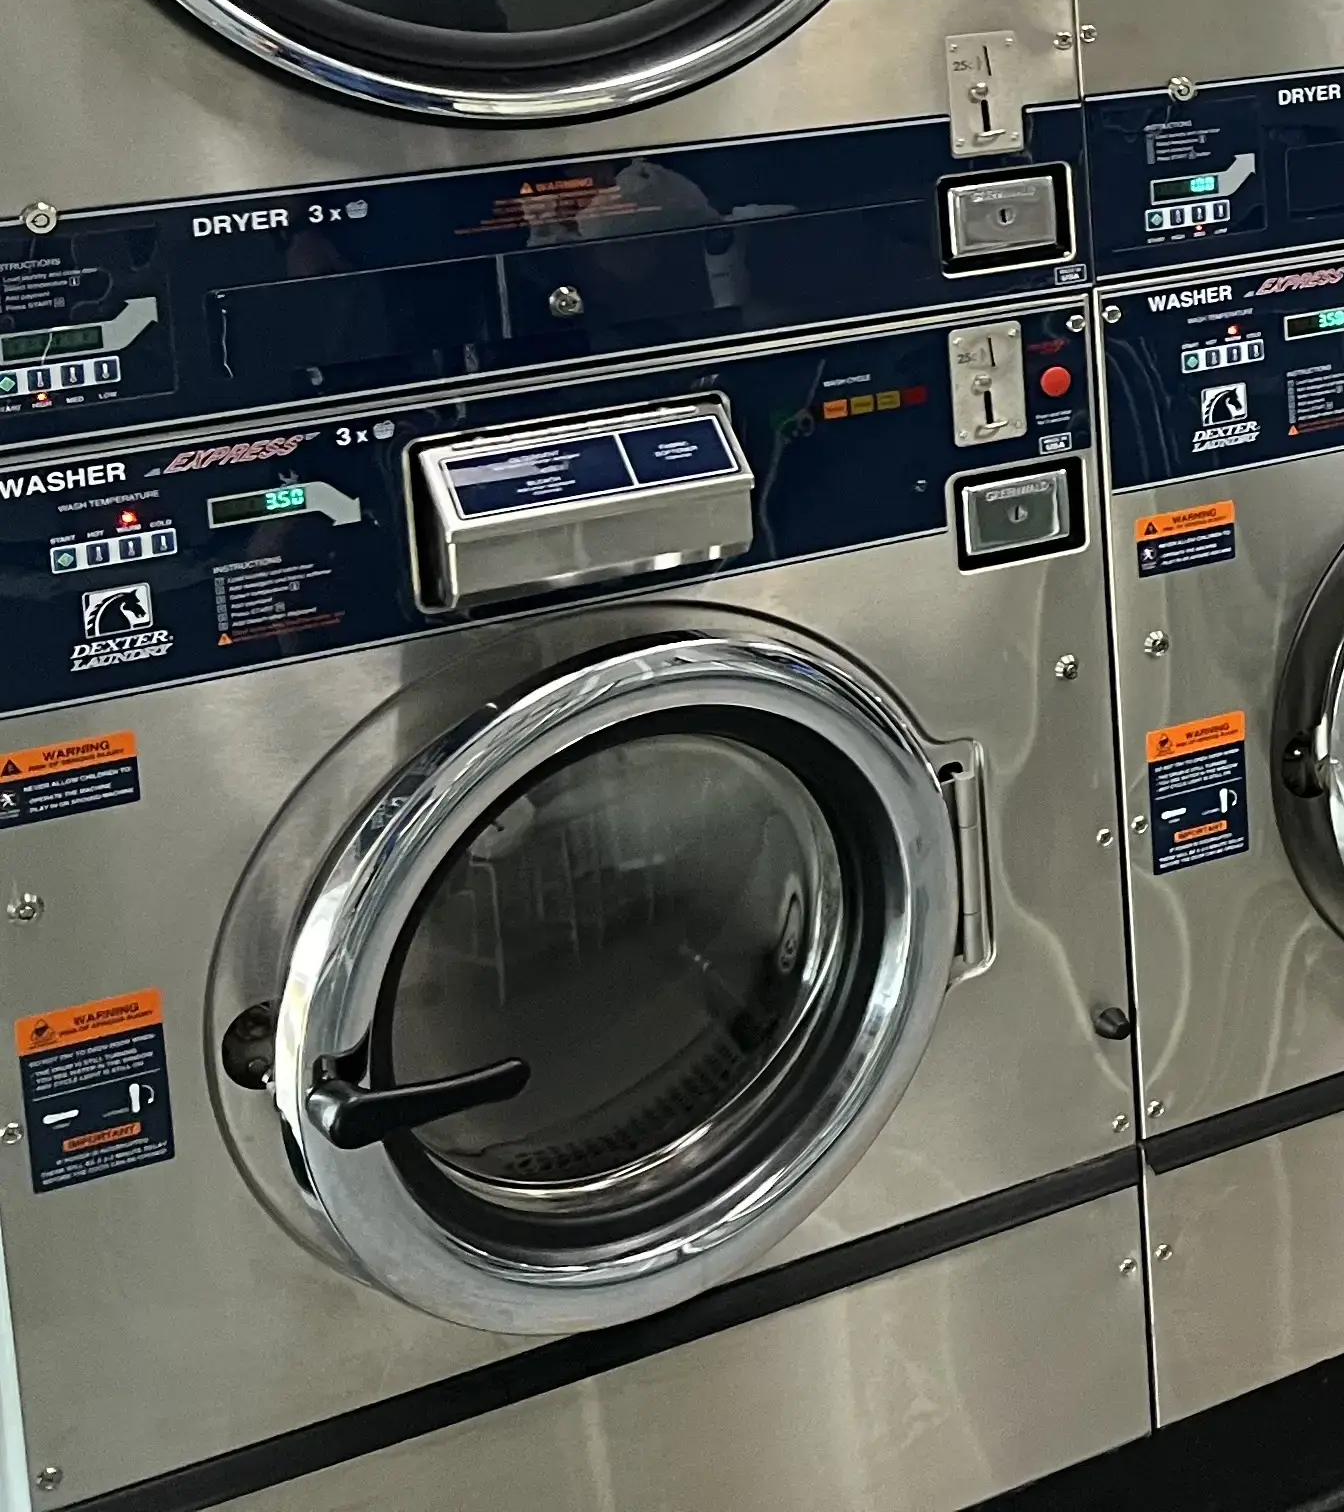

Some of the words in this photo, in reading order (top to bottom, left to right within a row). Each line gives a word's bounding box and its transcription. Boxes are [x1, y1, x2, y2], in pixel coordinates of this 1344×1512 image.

[1278, 84, 1341, 106] DRYER
[192, 208, 289, 238] DRYER
[308, 205, 324, 223] 3
[330, 208, 342, 221] x
[1148, 285, 1233, 313] WASHER
[1193, 421, 1257, 442] DEXTER
[0, 462, 126, 499] WASHER
[163, 435, 304, 475] EXPRESS
[336, 428, 351, 446] 3
[356, 430, 369, 443] x
[89, 490, 160, 508] TEMPERATURE
[70, 642, 173, 672] LAUNDRY
[71, 629, 169, 660] DEXTER
[42, 740, 110, 762] WARNING
[73, 1002, 140, 1026] WARNING
